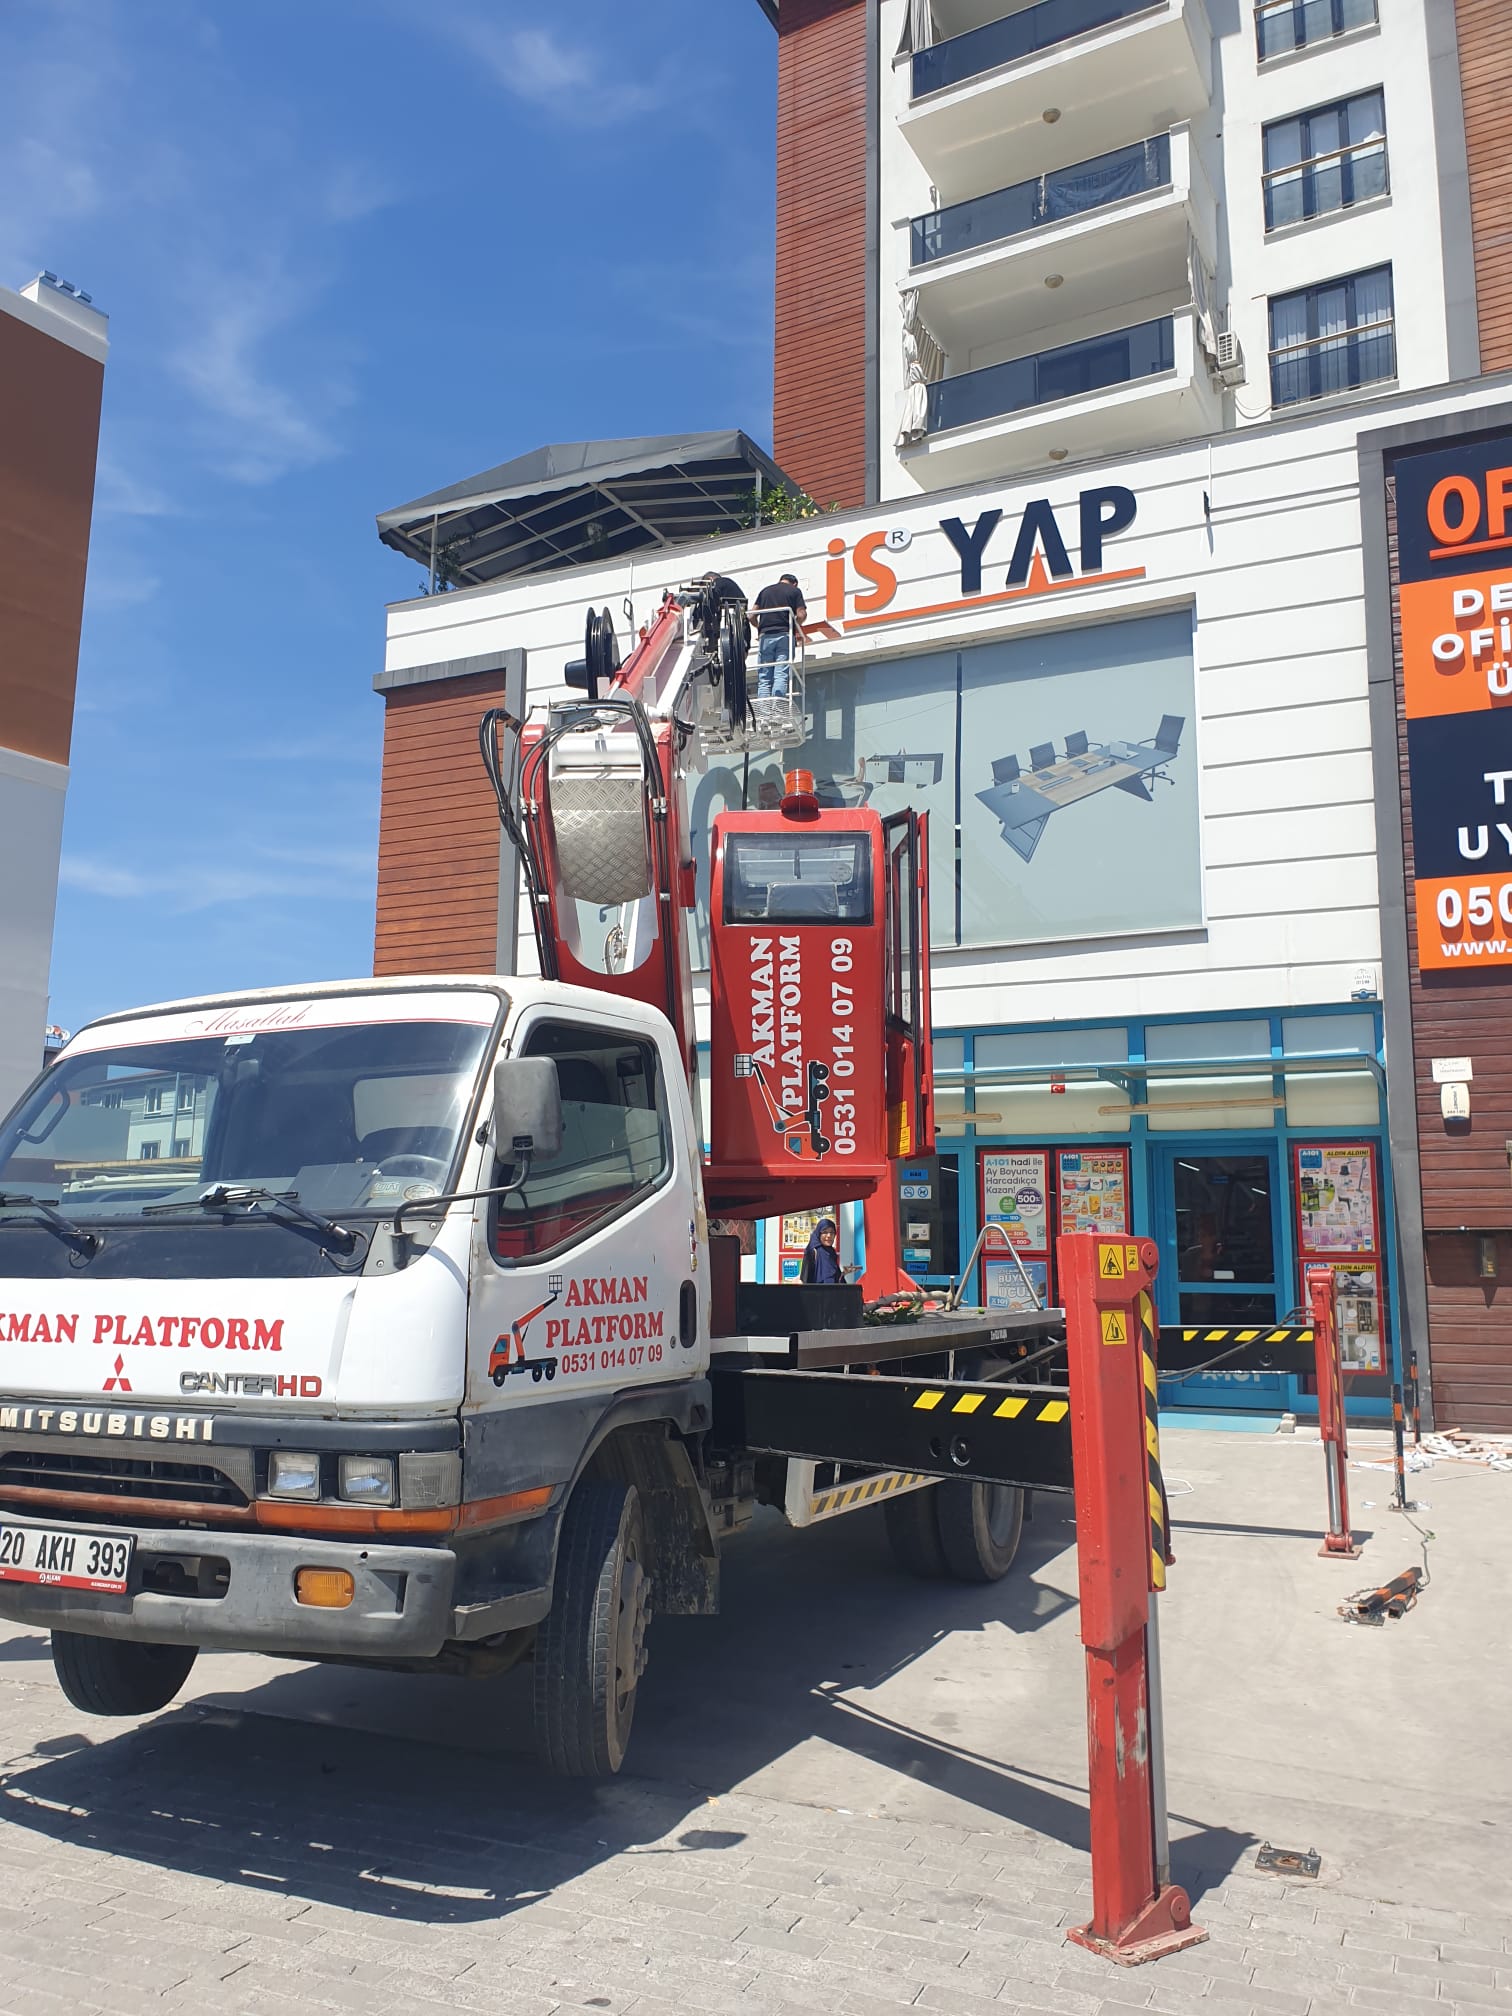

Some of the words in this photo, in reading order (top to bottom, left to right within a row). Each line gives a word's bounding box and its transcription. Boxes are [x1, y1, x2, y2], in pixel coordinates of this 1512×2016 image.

[939, 485, 1137, 597] YAP
[831, 938, 853, 972] 09
[750, 936, 774, 1068] AKMAN
[832, 982, 853, 1016] 07
[779, 935, 803, 1108] PLATFORM
[832, 1024, 855, 1077] 014
[833, 1089, 856, 1155] 0531
[986, 1168, 997, 1177] Ay
[1000, 1168, 1039, 1177] Boyunca
[1011, 1158, 1031, 1166] hadi
[986, 1186, 1016, 1194] Kazan!
[1017, 1195, 1036, 1203] 500
[565, 1276, 648, 1307] AKMAN
[0, 1313, 79, 1343] MAN
[93, 1314, 284, 1351] PLATFORM
[545, 1311, 664, 1348] PLATFORM
[562, 1352, 595, 1374] 0531
[601, 1348, 625, 1369] 014
[629, 1346, 644, 1365] 07
[648, 1344, 663, 1362] 09
[0, 1407, 214, 1441] MITSUBISHI
[0, 1531, 25, 1565] 20
[35, 1535, 76, 1572] AKH
[87, 1540, 127, 1578] 393
